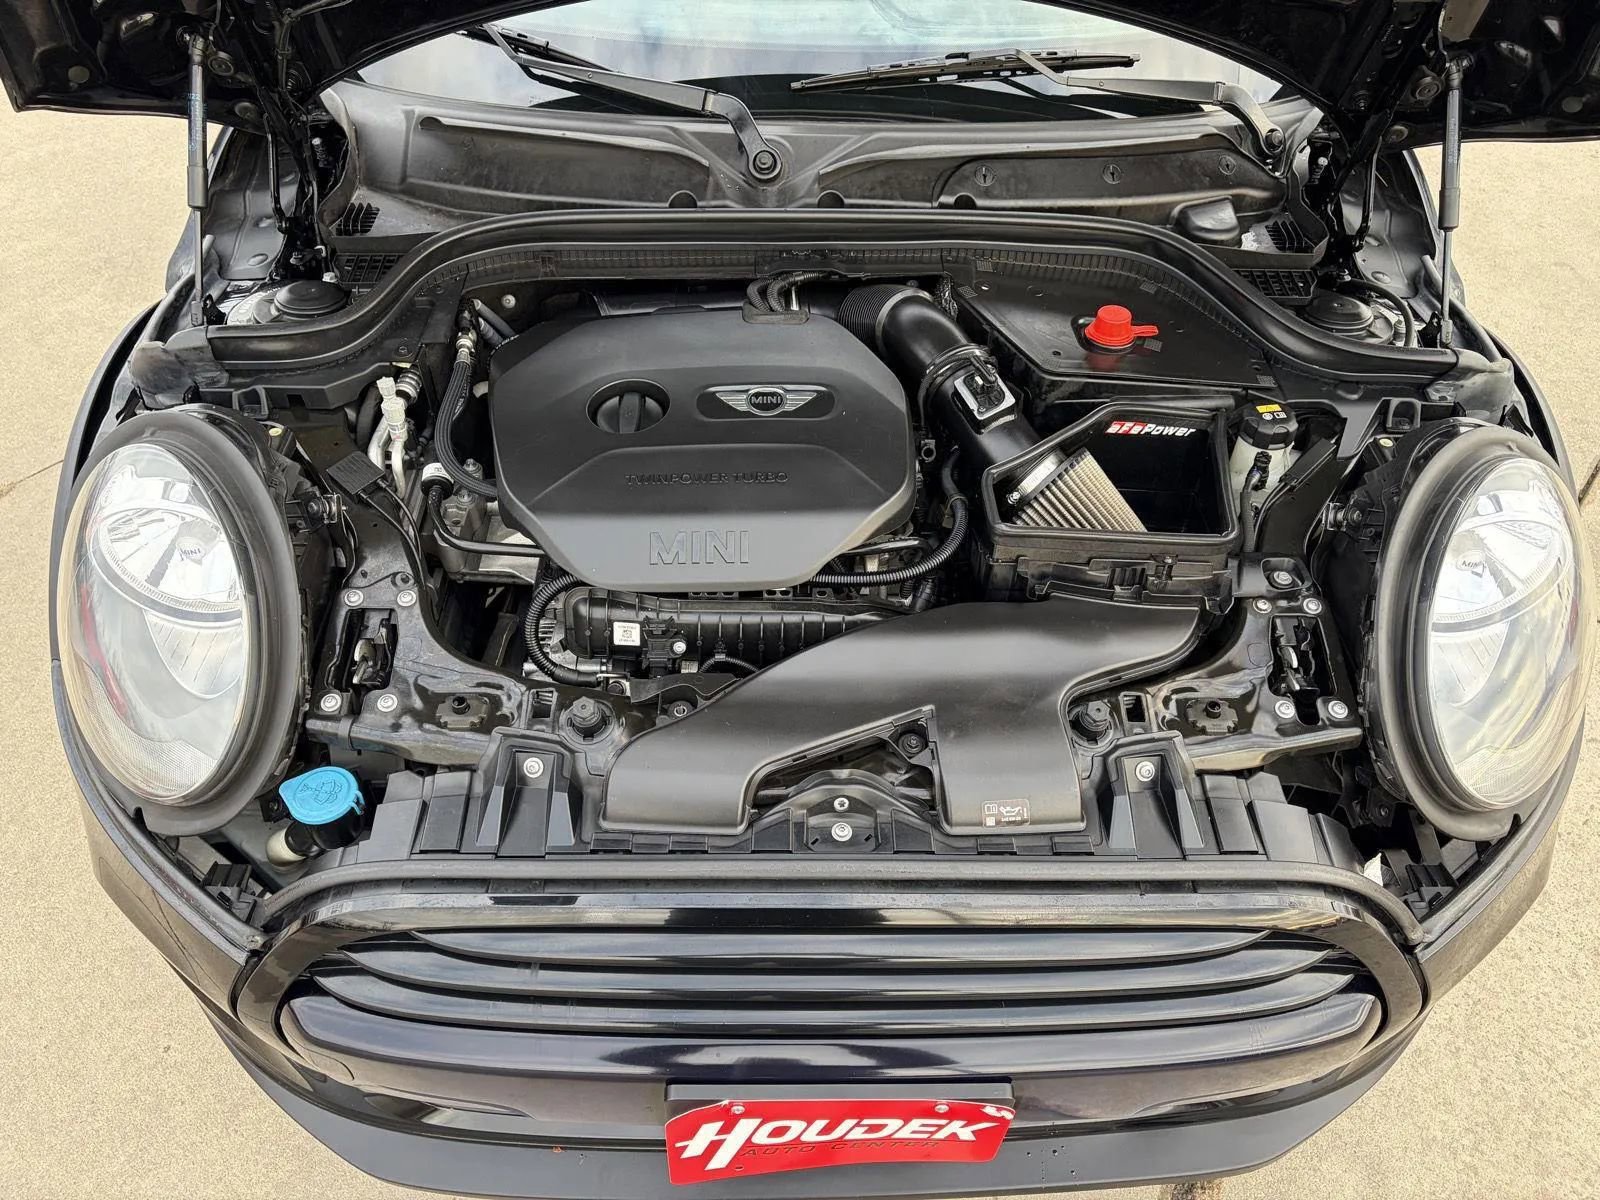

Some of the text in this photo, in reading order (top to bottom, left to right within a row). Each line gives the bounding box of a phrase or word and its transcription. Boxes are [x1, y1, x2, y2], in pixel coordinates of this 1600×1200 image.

[751, 396, 783, 404] MINI
[625, 471, 789, 485] TWINPOWER TURBO
[649, 530, 750, 566] MINI
[675, 1118, 1000, 1171] HOUDEK
[739, 1141, 939, 1157] AUTO CENTER
